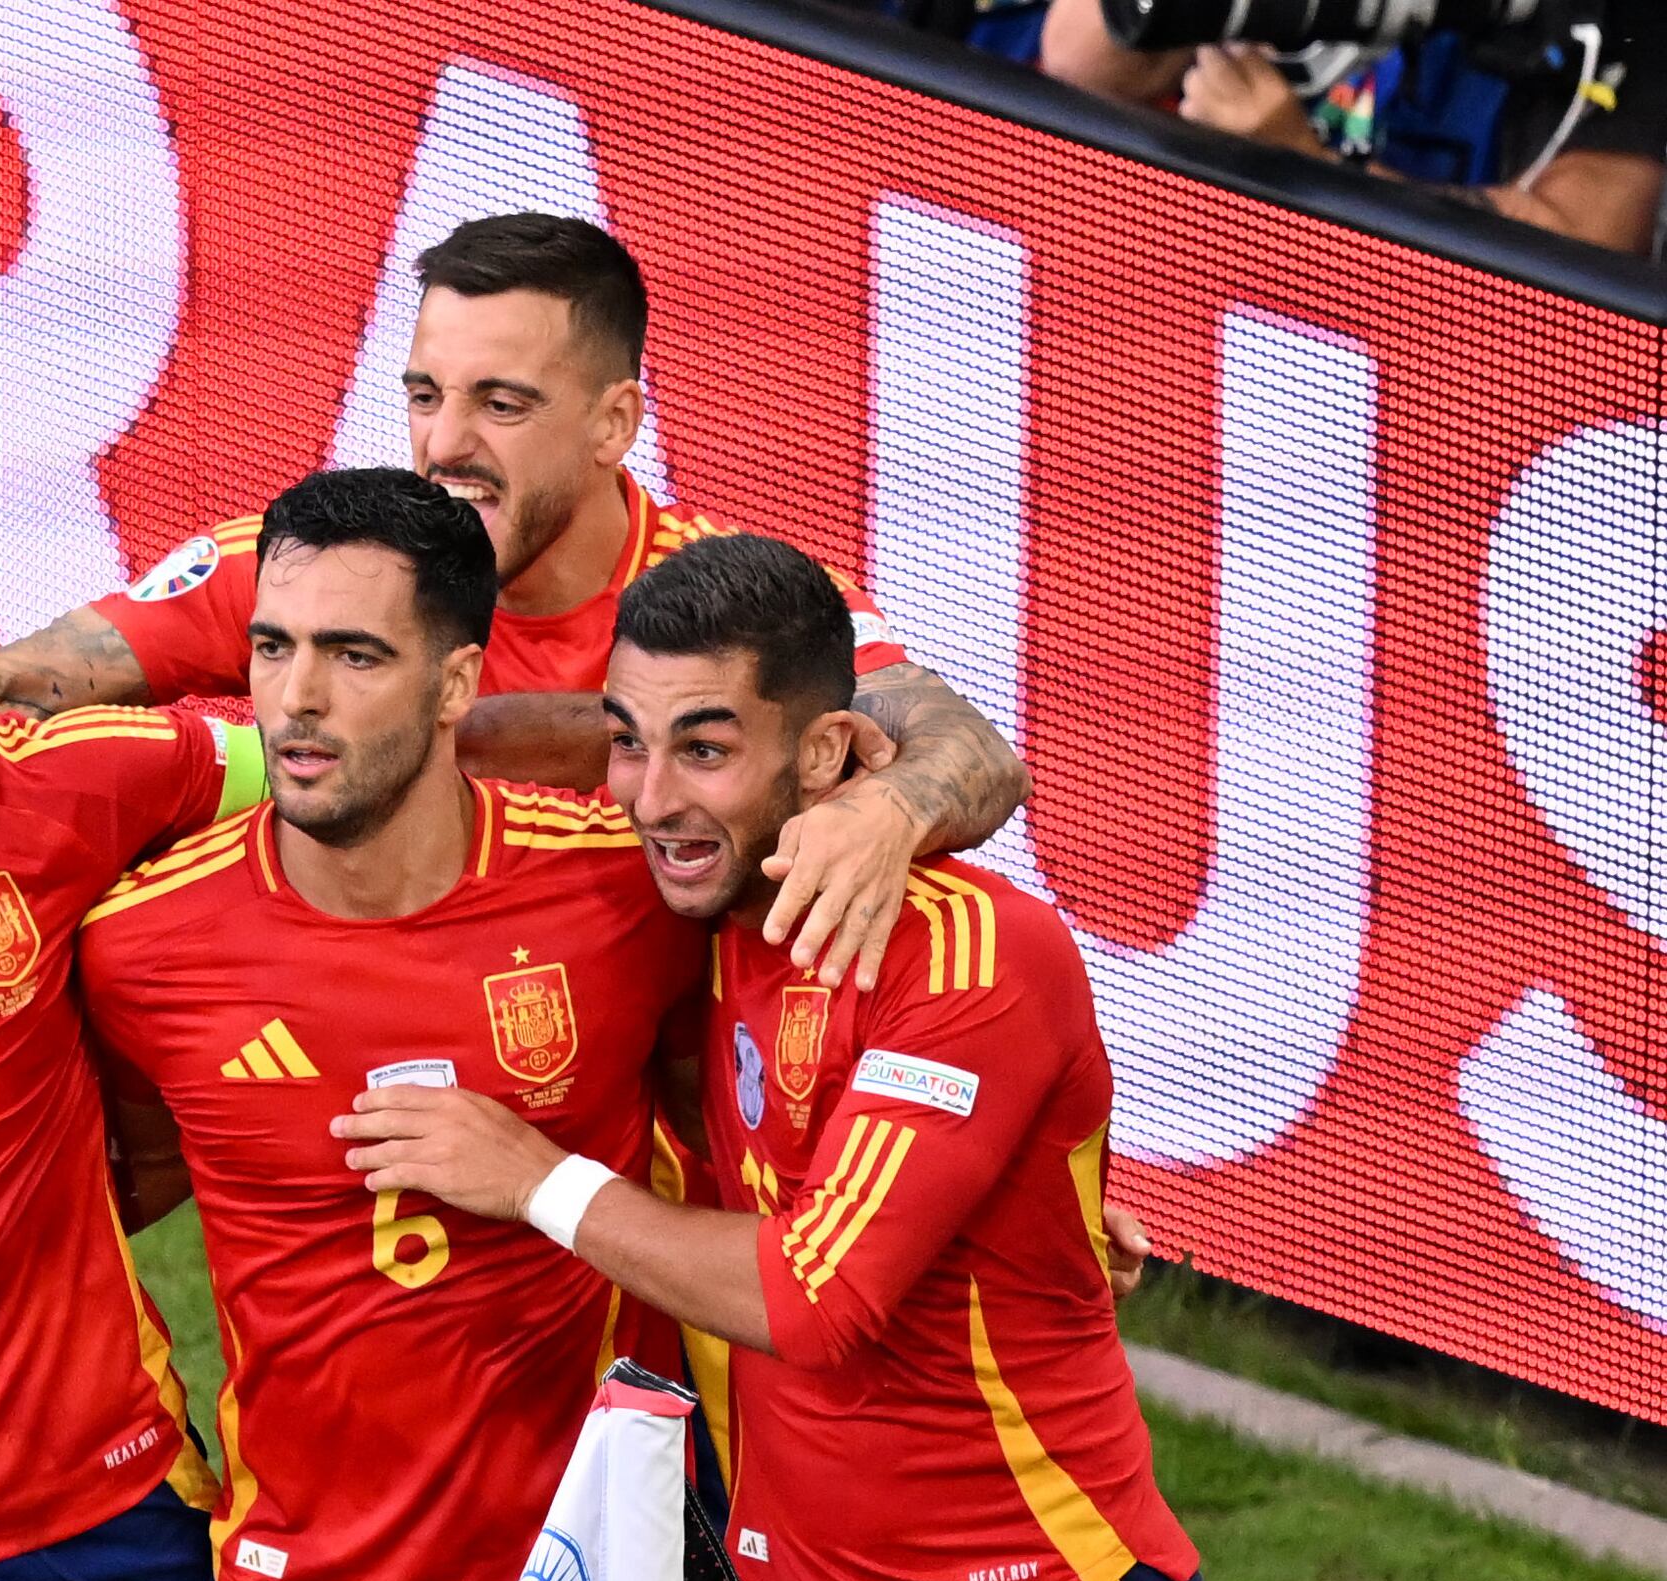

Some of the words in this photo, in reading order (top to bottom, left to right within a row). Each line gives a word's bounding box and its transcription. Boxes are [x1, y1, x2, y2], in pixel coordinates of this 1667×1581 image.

[858, 1062, 973, 1101] FOUNDATION
[371, 1187, 451, 1289] 6
[103, 1426, 159, 1470] HEAT.RDY
